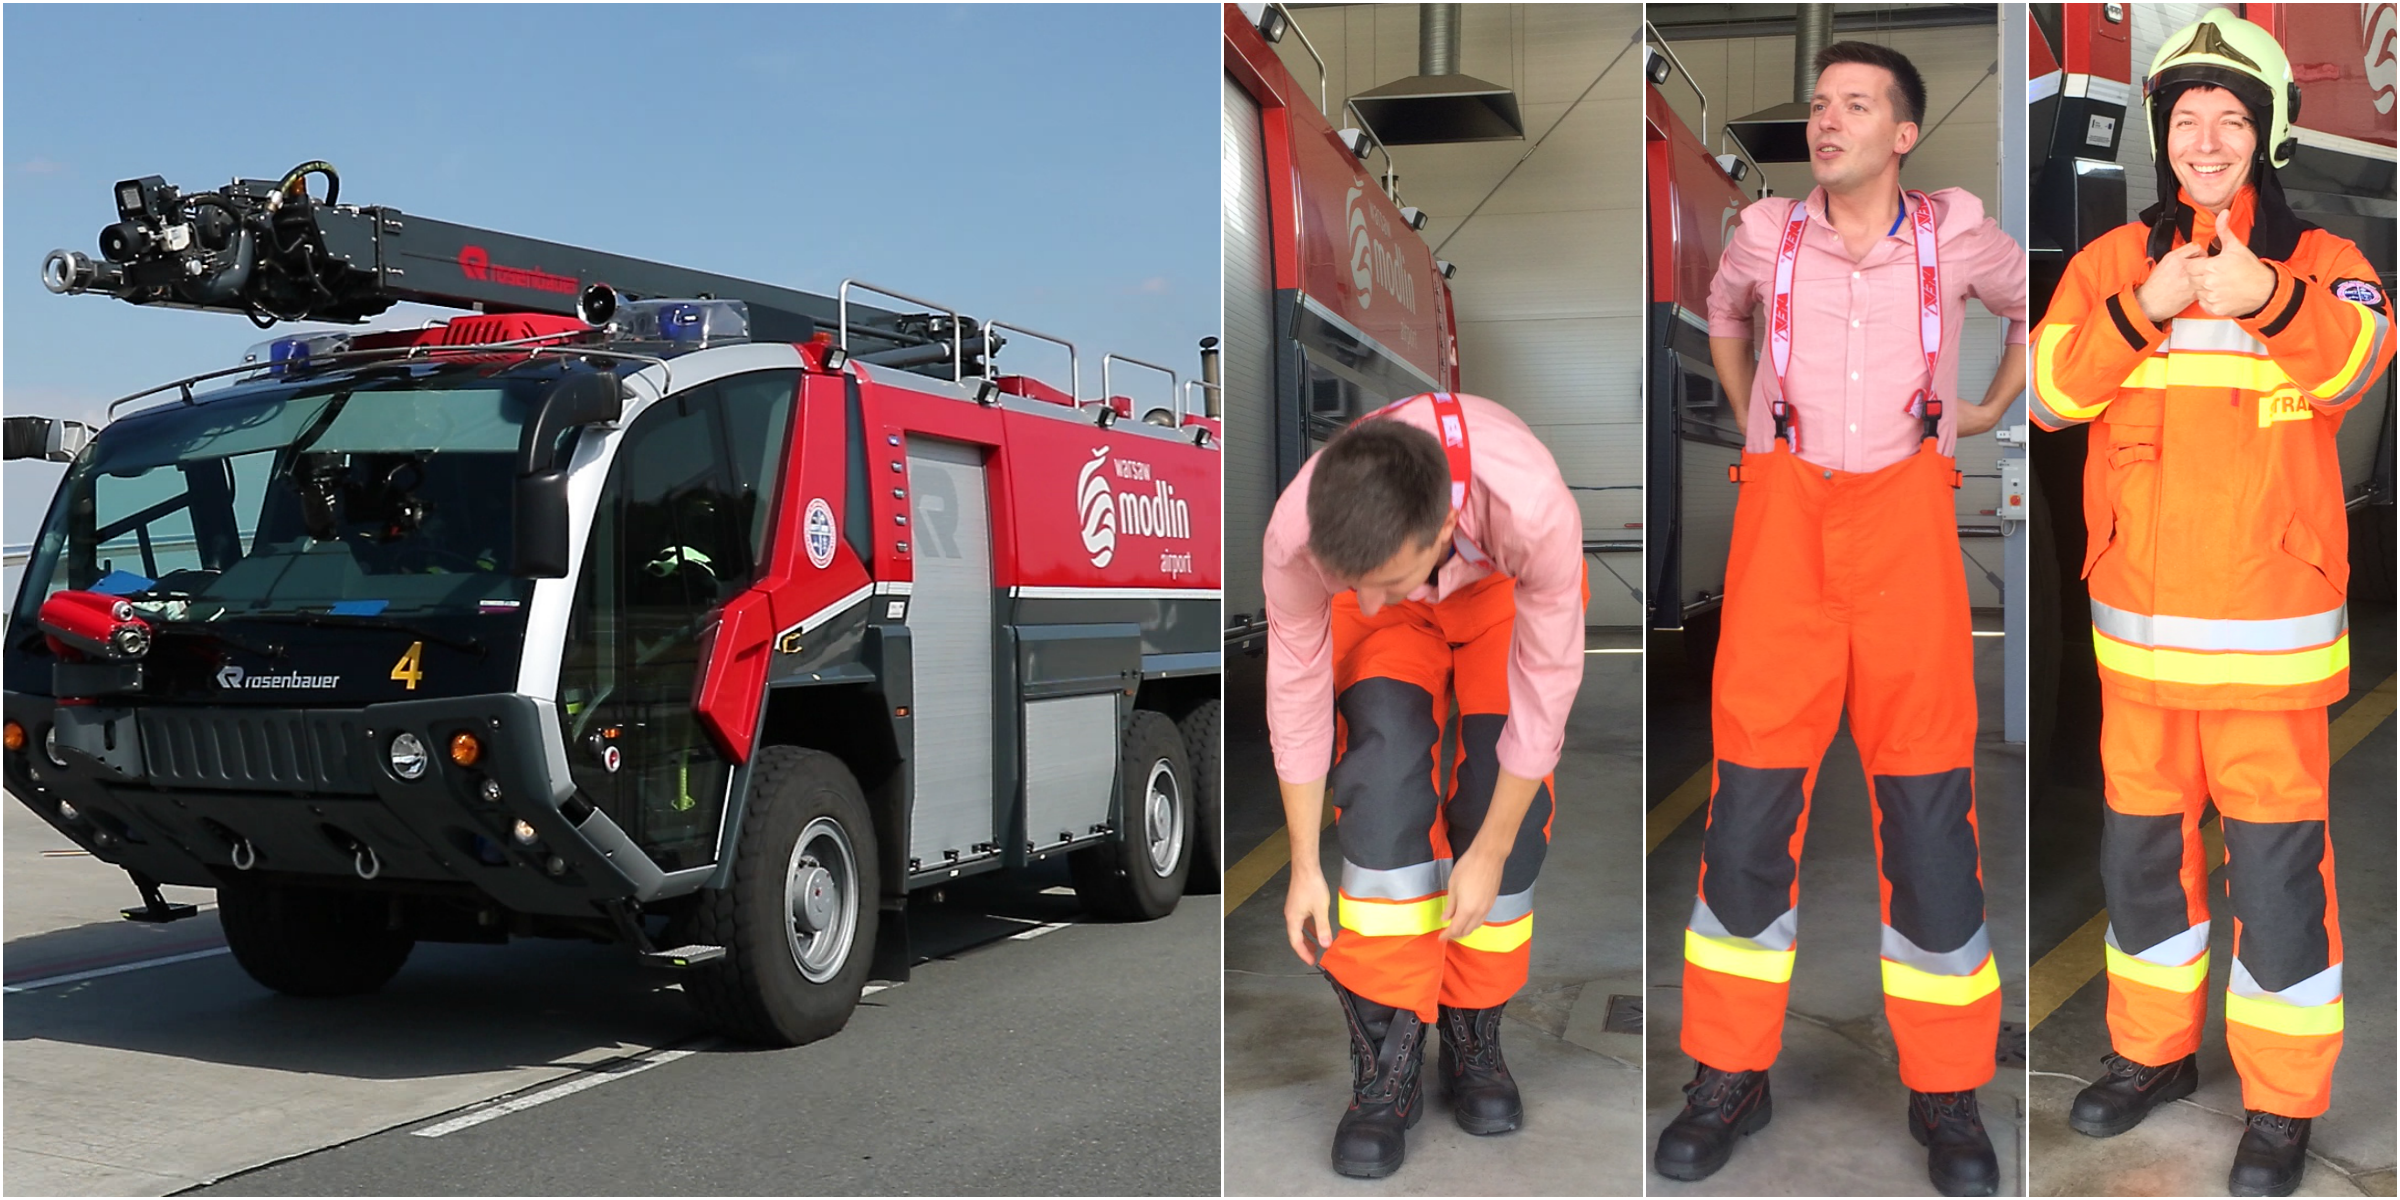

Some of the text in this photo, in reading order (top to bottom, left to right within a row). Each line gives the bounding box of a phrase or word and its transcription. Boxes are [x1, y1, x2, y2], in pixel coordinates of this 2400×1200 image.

[1373, 238, 1416, 315] modlin
[1113, 458, 1151, 481] warsaw
[1118, 479, 1190, 539] modlin
[1160, 548, 1192, 580] airport
[244, 671, 340, 689] rosenbauer
[390, 641, 423, 690] 4
